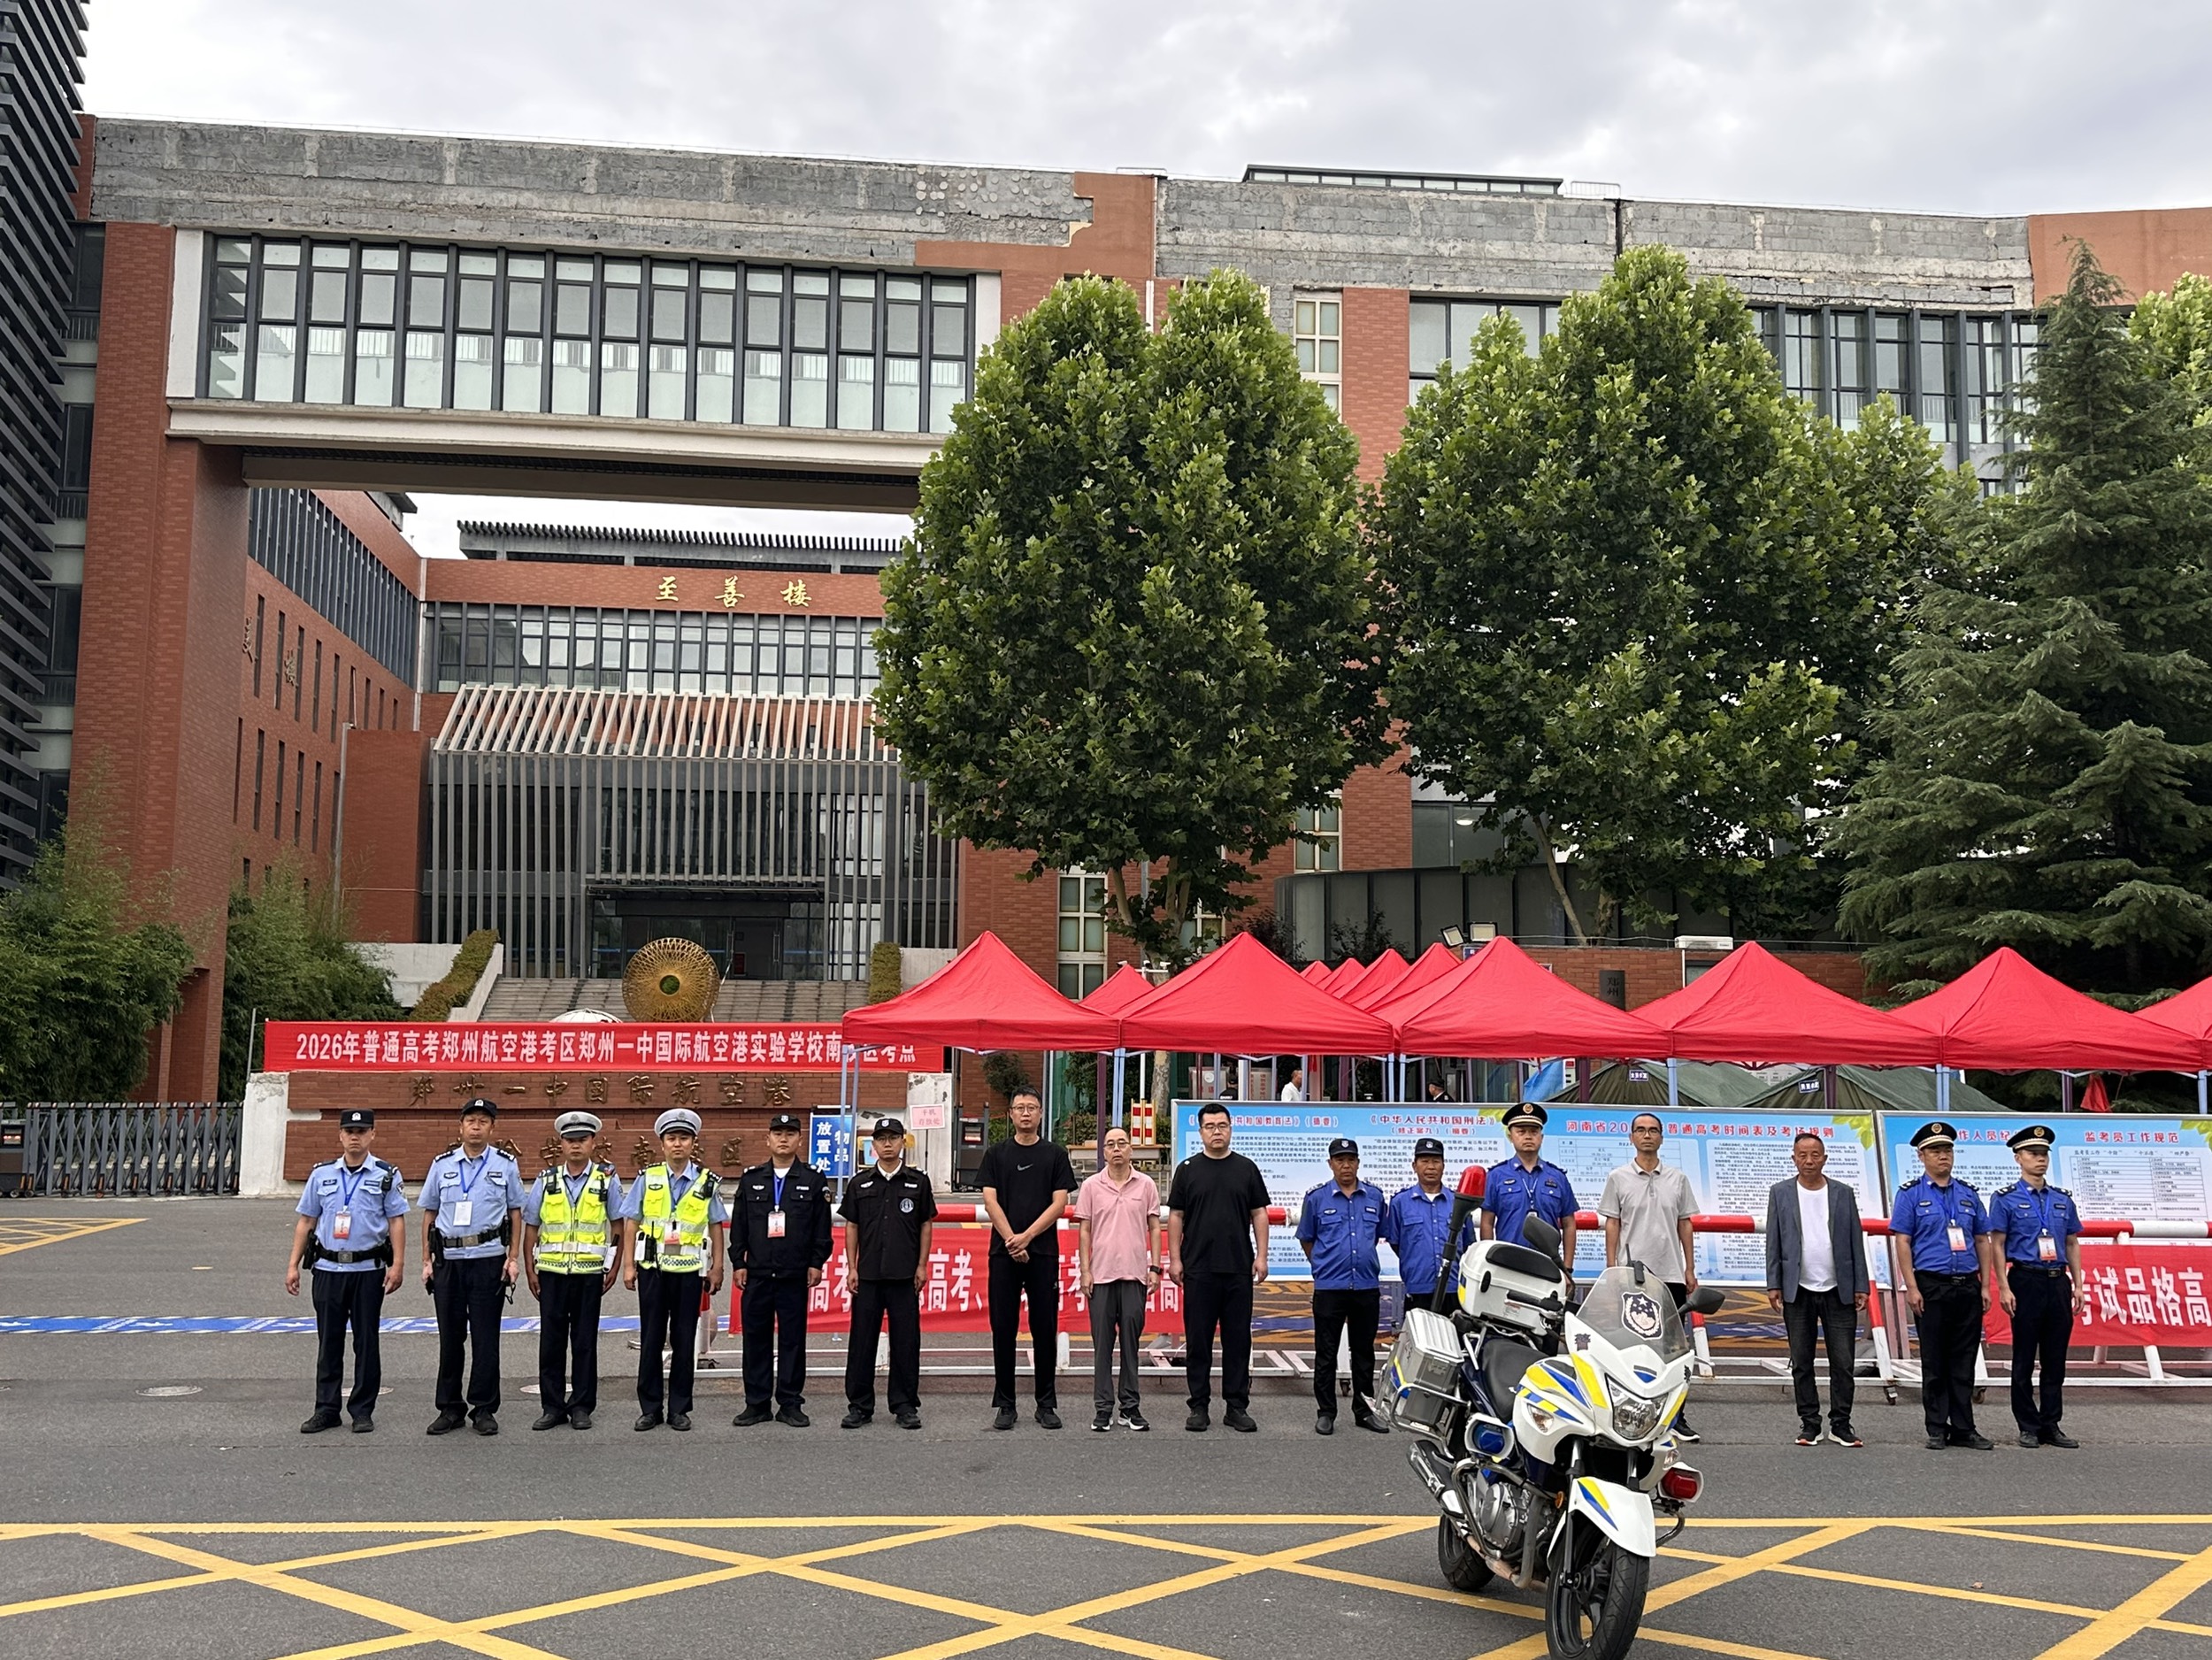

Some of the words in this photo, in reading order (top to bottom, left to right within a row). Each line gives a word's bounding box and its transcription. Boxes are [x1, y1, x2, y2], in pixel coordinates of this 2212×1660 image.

[656, 575, 811, 608] 至善楼
[296, 1029, 916, 1063] 2026年普通高考郑州航空港考区郑州一中国际航空港实验学校南考点
[409, 1074, 791, 1106] 郑州一中国际航空港
[1566, 1121, 1833, 1138] 河南省20普通高考时间表及考场规则
[2085, 1133, 2178, 1142] 监考员工作规范
[816, 1122, 832, 1173] 放置处
